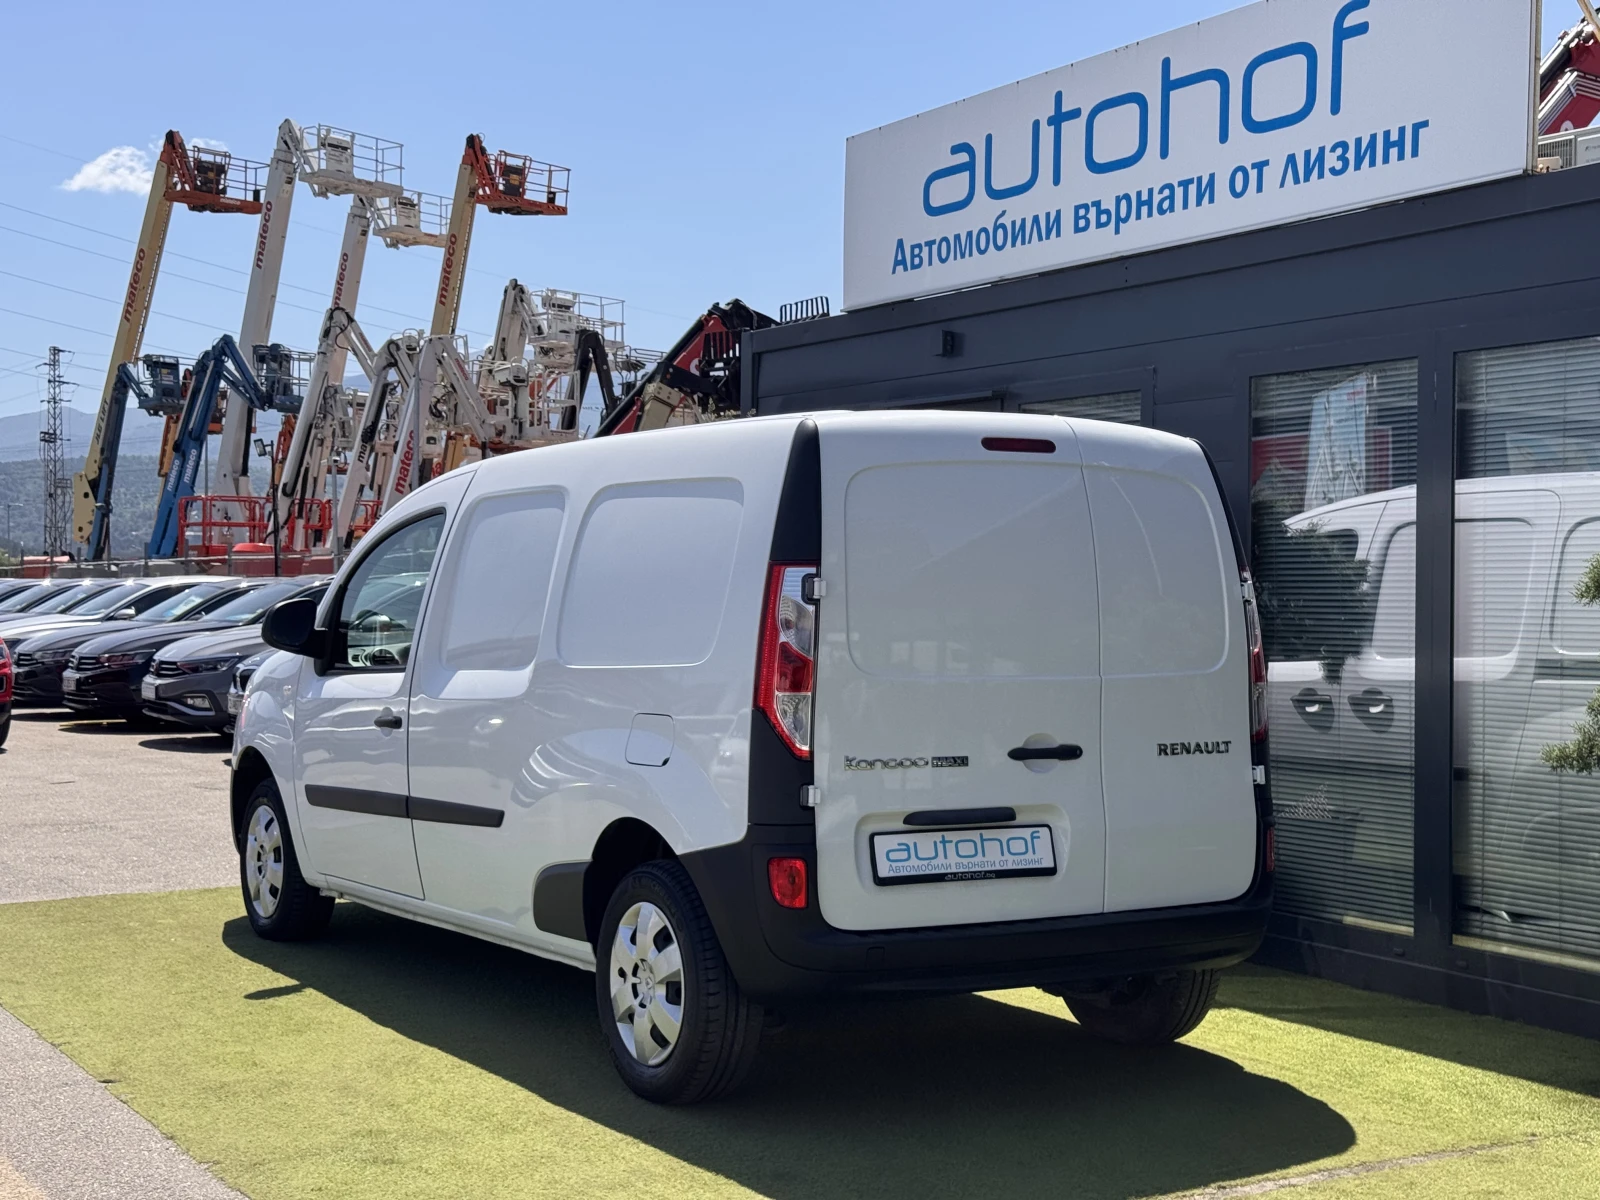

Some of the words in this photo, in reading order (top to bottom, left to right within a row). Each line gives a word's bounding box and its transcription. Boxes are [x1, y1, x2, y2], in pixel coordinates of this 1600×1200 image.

[922, 0, 1370, 216] autohof
[891, 209, 1062, 275] Автомобили
[1073, 172, 1216, 235] върнати
[1229, 159, 1270, 199] от
[1279, 119, 1430, 189] лизинг
[255, 200, 273, 270] mateco
[123, 247, 146, 323] mateco
[438, 233, 457, 307] mateco
[166, 459, 180, 491] mateco
[183, 448, 197, 483] mateco
[1157, 740, 1232, 756] RENAULT
[885, 830, 1041, 863] autohof
[887, 860, 952, 875] Автомобили
[955, 861, 996, 871] върнати
[998, 859, 1009, 867] от
[1011, 857, 1044, 867] лизинг
[944, 871, 996, 880] autohof.bg
